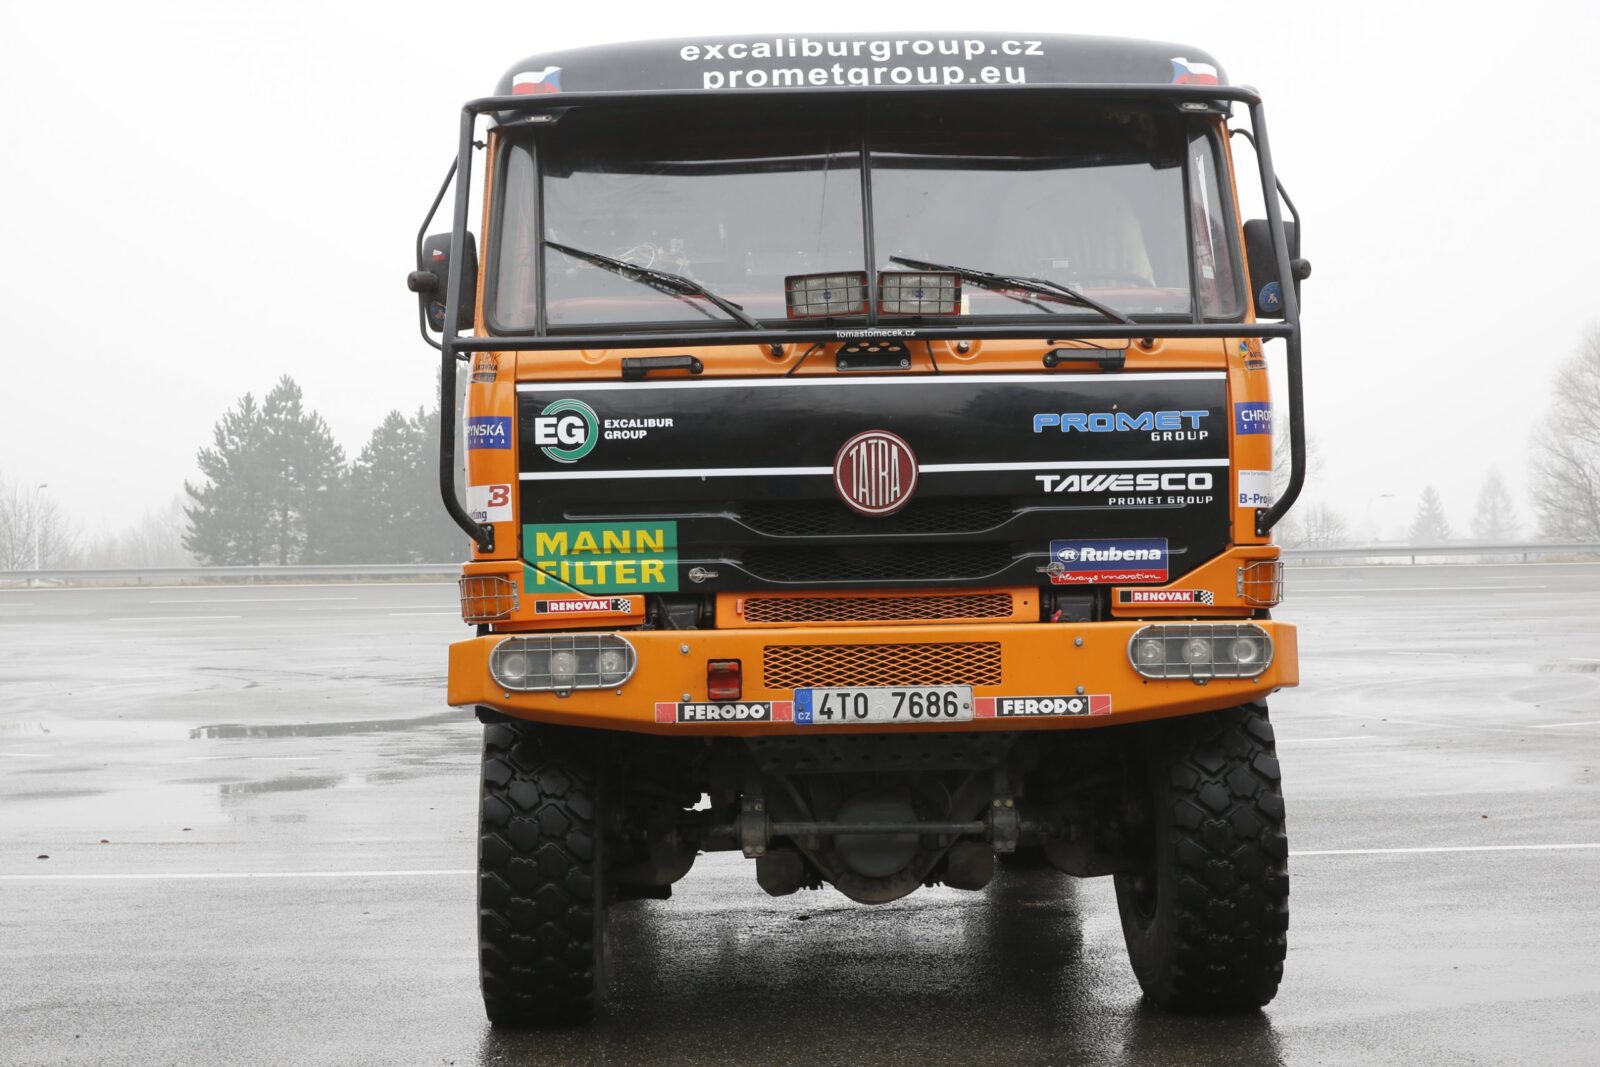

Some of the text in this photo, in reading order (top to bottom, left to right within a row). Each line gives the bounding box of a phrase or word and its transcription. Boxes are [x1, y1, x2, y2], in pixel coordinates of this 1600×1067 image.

[680, 38, 1044, 61] excaliburgroup.cz
[703, 63, 1026, 89] prometgroup.eu
[836, 328, 916, 338] tomastomecek.cz
[604, 418, 673, 429] EXCALIBUR
[1033, 410, 1209, 433] PROMET
[534, 416, 585, 445] EG
[604, 430, 647, 440] GROUP
[1151, 430, 1209, 442] GROUP
[849, 439, 900, 506] TATRA
[1035, 472, 1213, 493] TAWESCO
[1108, 495, 1213, 506] PROMET GROUP
[535, 529, 664, 557] MANN
[1080, 546, 1162, 562] Rubena
[535, 558, 666, 585] FILTER
[1134, 591, 1191, 601] RENOVAK
[550, 601, 608, 612] RENOVAK
[684, 703, 765, 720] FERODO
[891, 691, 958, 718] 7686
[1003, 698, 1084, 715] FERODO
[798, 711, 811, 720] CZ
